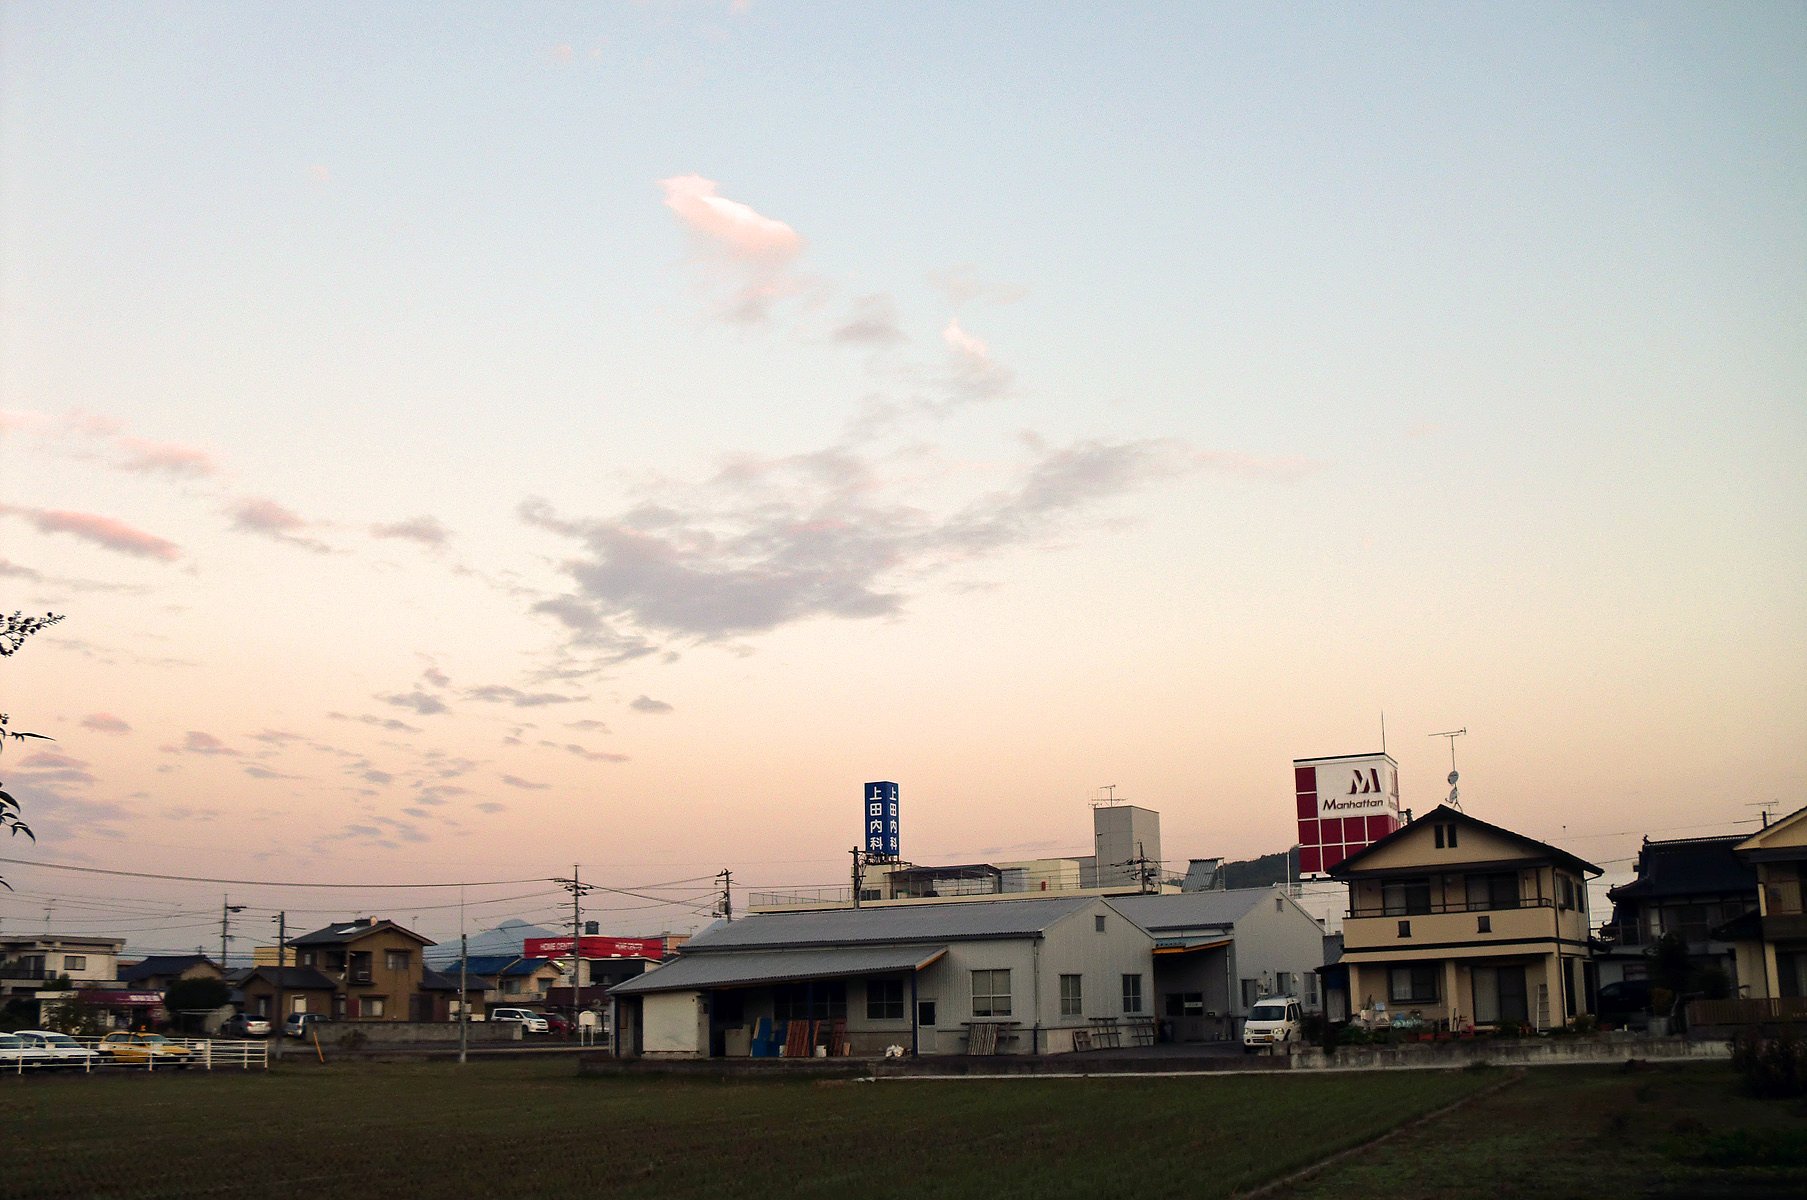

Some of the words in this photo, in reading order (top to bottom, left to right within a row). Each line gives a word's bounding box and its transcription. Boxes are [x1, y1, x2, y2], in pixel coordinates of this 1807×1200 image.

[869, 786, 883, 850] 上田内科
[889, 787, 897, 850] 上田内科
[1323, 799, 1383, 810] Manhattan
